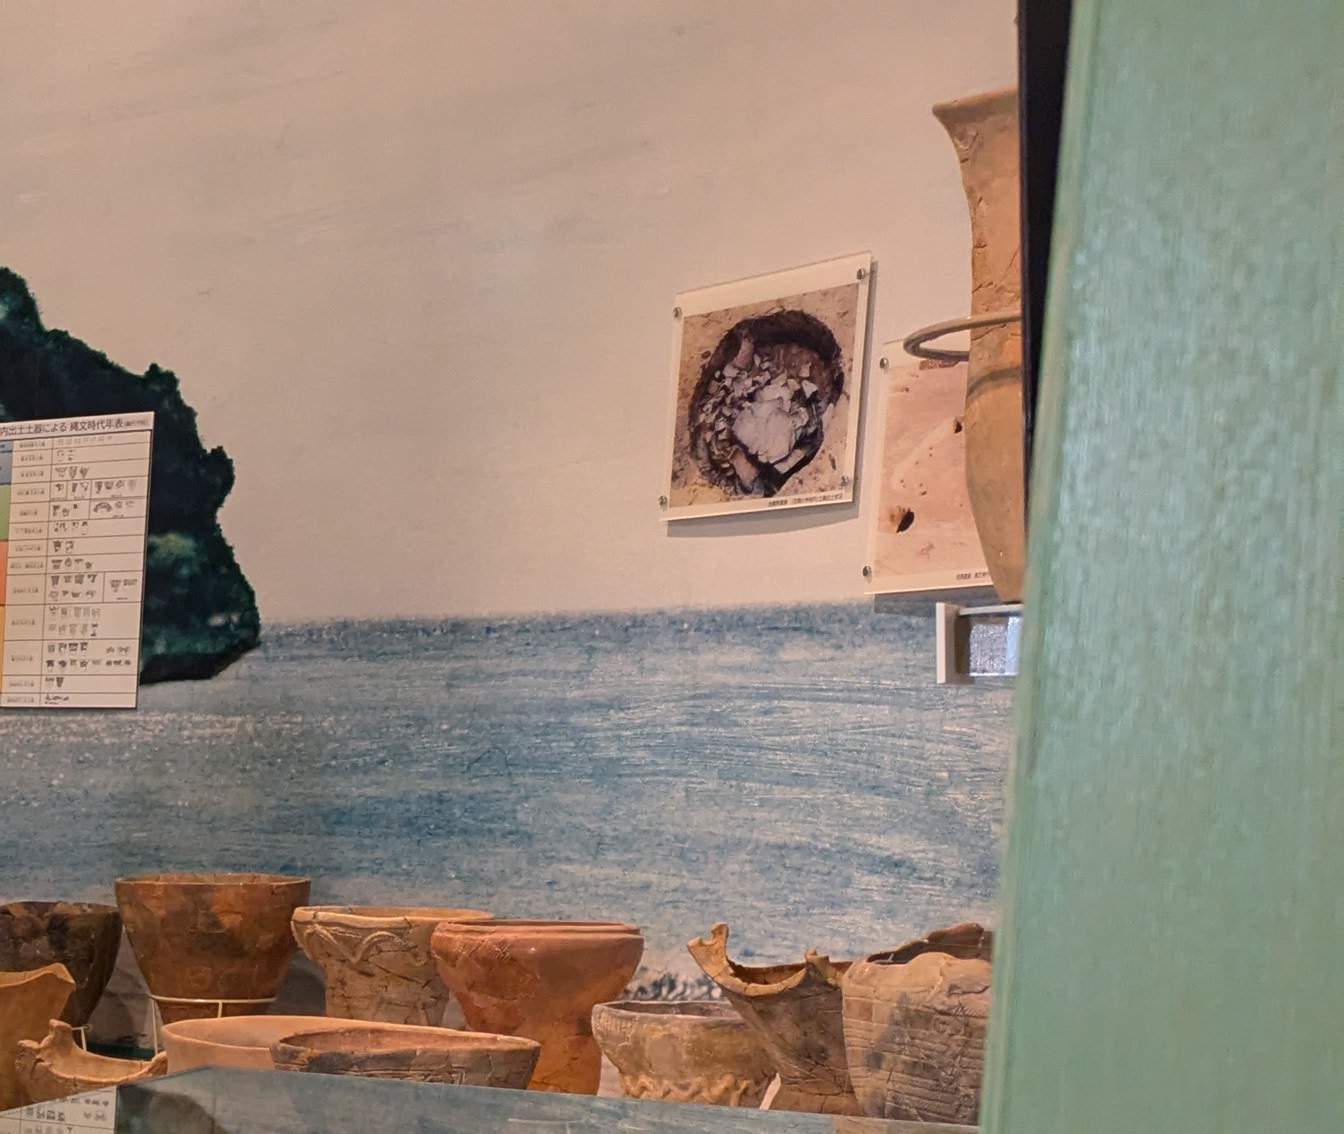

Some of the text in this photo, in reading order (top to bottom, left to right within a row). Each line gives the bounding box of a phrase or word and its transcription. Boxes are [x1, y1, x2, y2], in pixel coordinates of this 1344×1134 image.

[70, 418, 123, 432] 縄文時代年表
